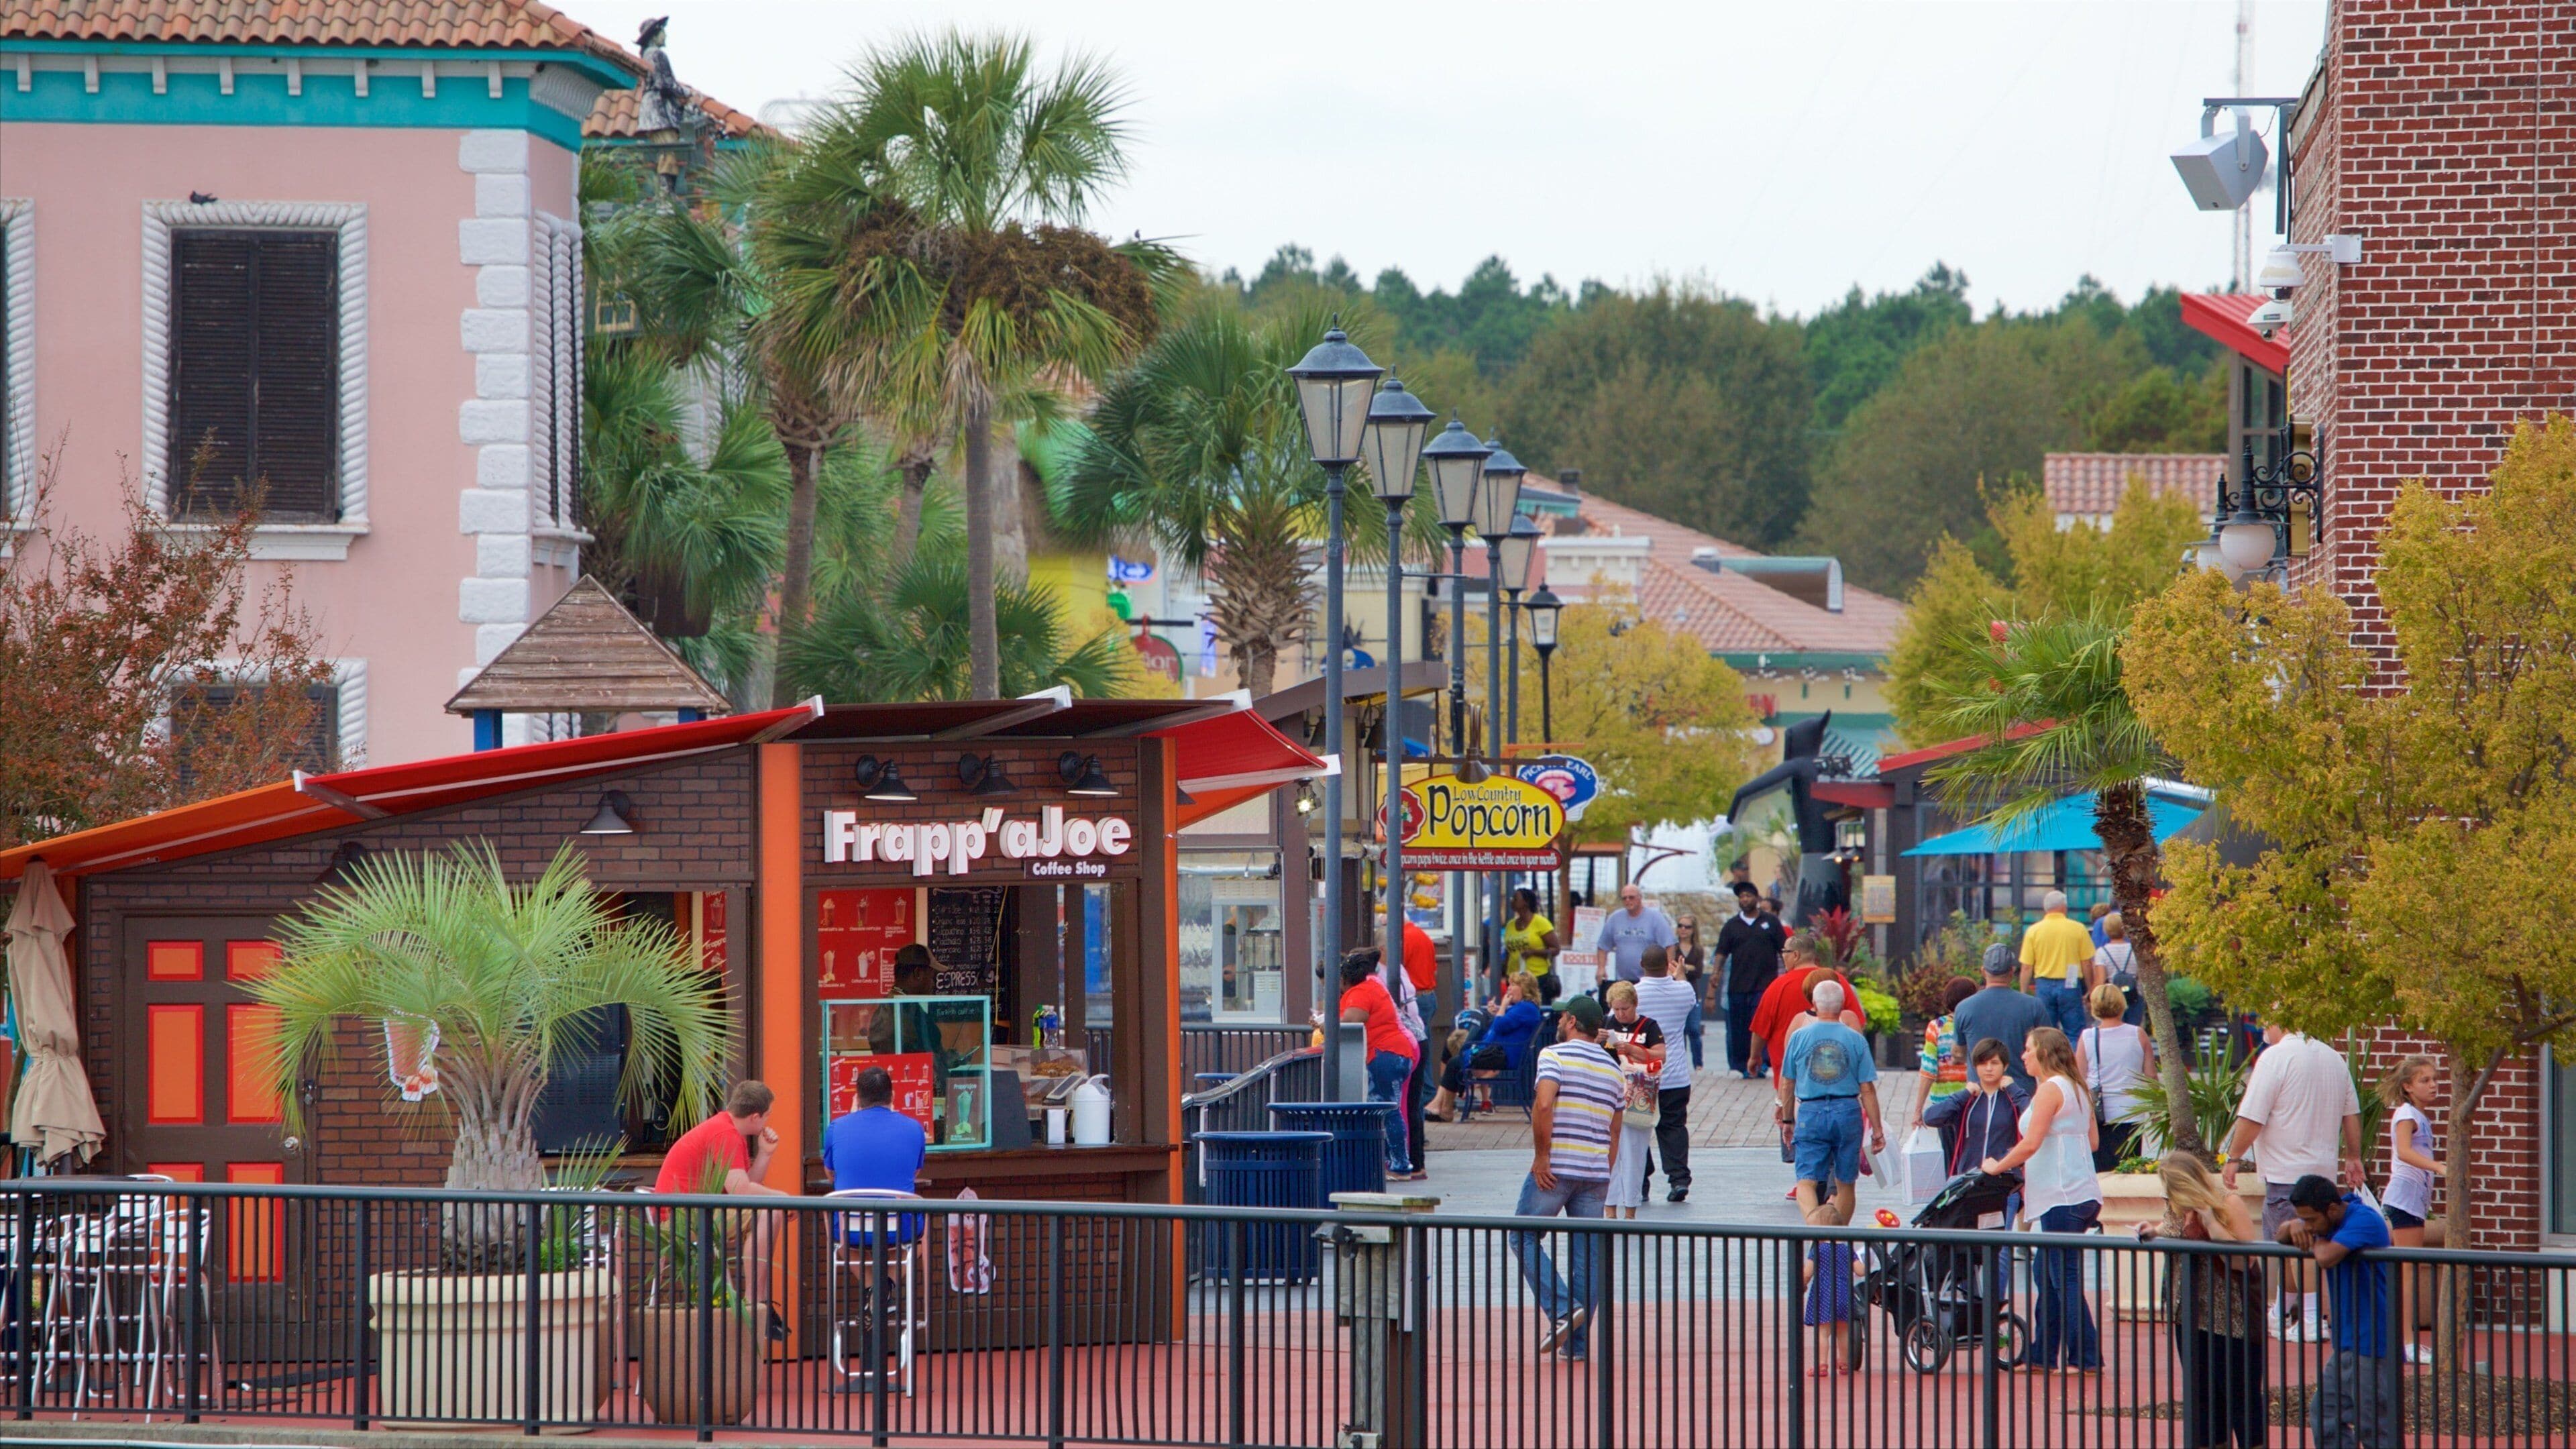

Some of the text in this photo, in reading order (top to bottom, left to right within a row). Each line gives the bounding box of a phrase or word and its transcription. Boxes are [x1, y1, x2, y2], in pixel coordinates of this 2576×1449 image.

[1566, 759, 1593, 781] EARL
[1427, 785, 1552, 848] Popcorn
[1032, 861, 1106, 876] Coffee Shop
[1417, 855, 1432, 868] pops
[1462, 853, 1468, 865] in
[1468, 852, 1478, 865] the
